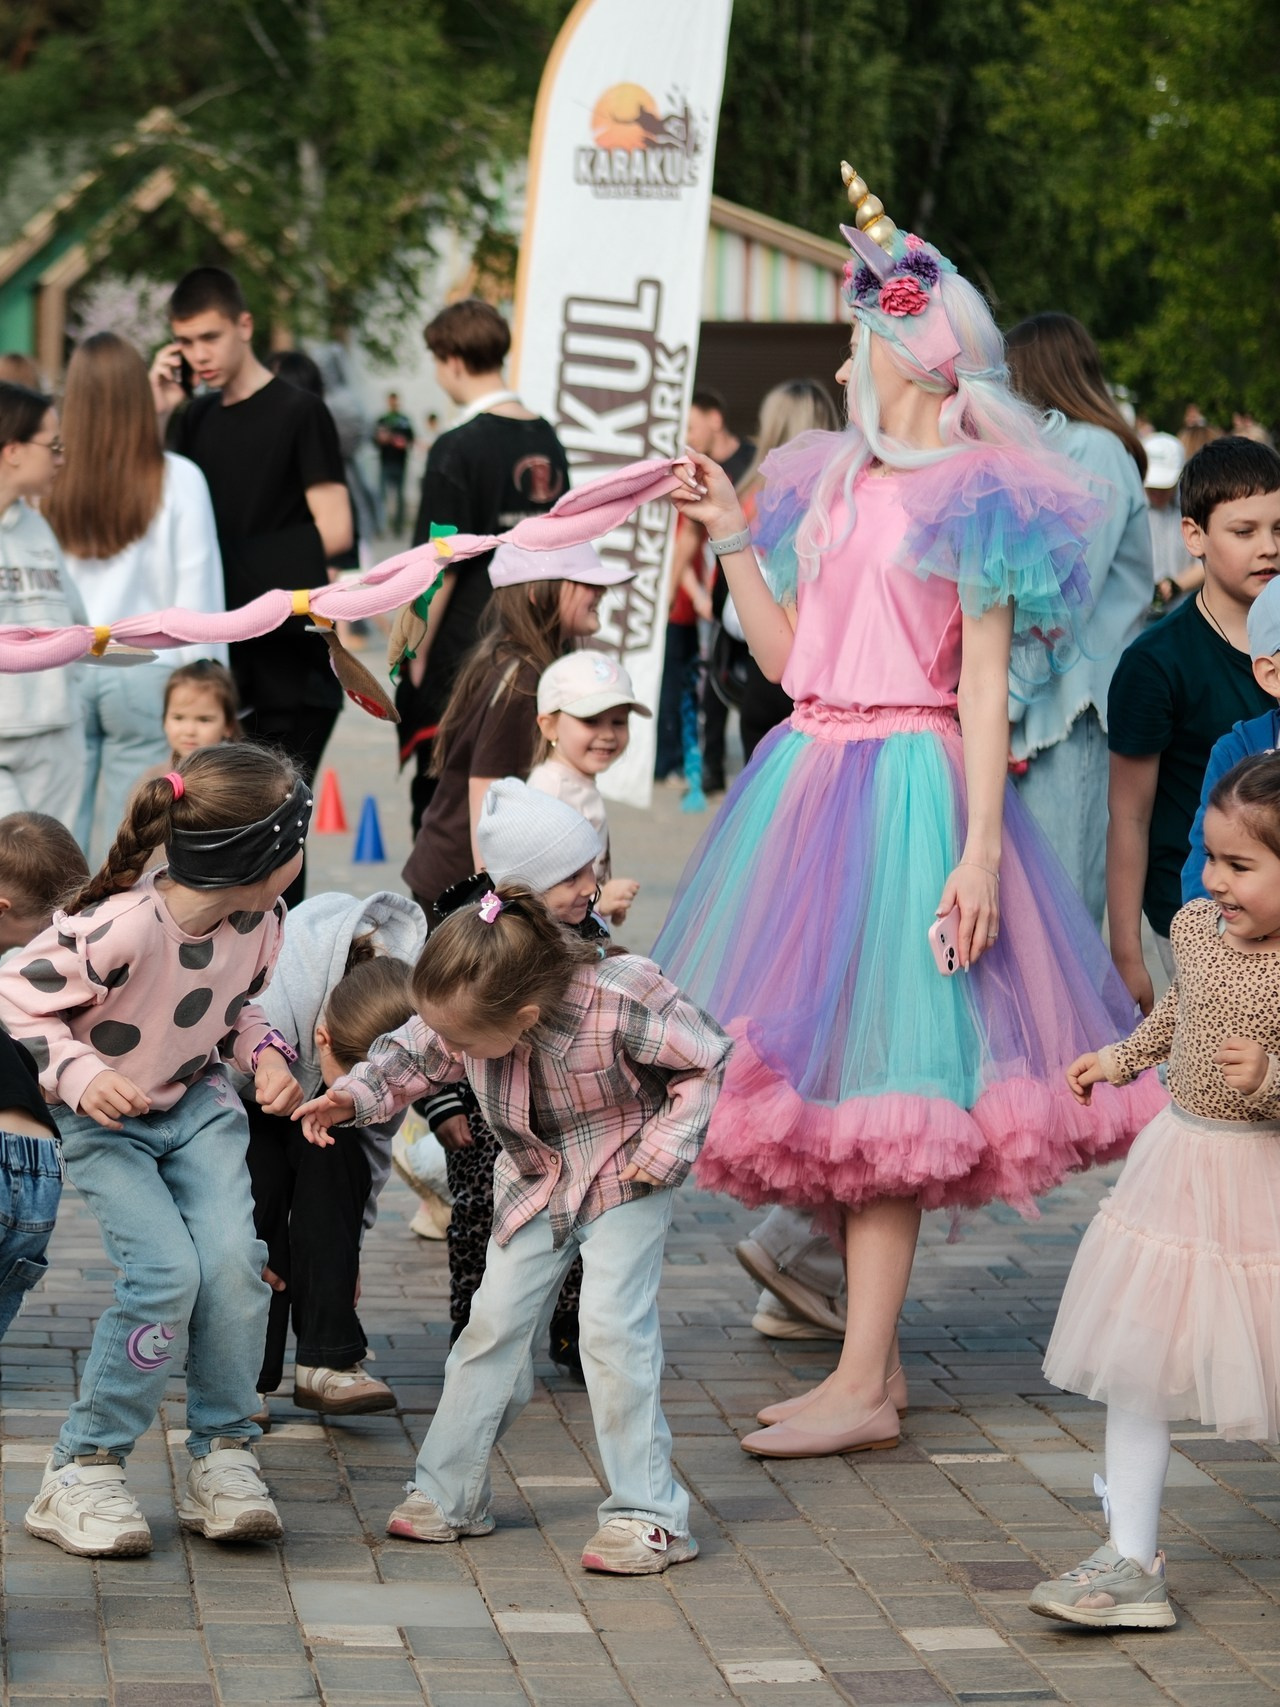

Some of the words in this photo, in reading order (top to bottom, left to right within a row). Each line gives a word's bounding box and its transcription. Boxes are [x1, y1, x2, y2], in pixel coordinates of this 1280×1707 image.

[575, 147, 698, 186] KARAKUL
[625, 497, 670, 649] WAKE
[648, 343, 688, 461] ARK
